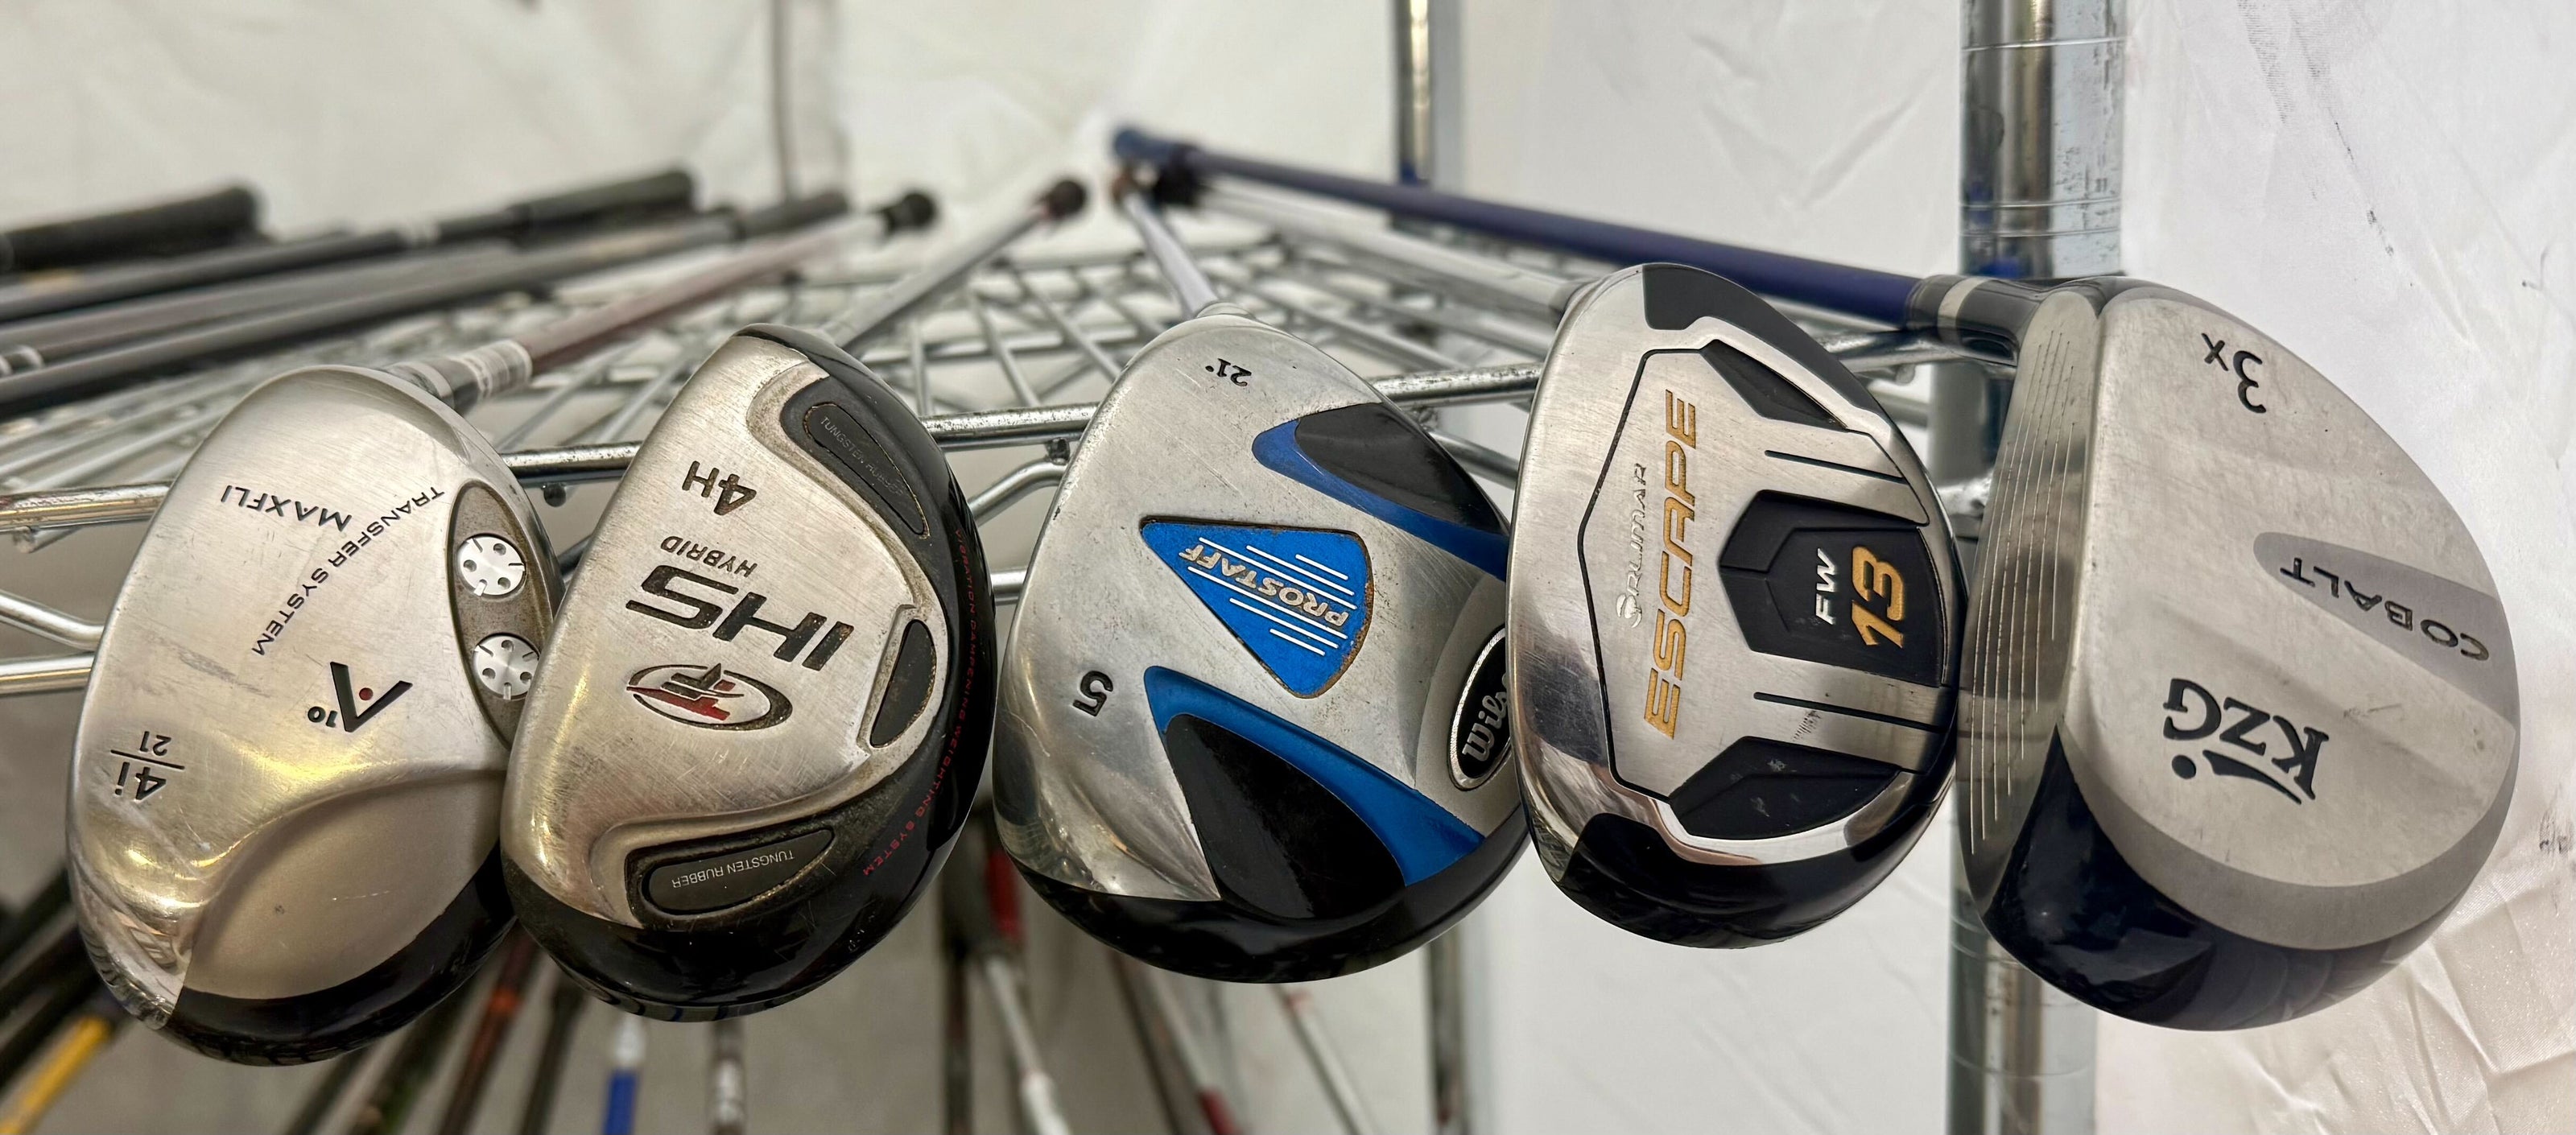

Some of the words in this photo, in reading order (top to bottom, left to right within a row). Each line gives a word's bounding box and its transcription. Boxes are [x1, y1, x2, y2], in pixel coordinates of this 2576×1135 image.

[221, 485, 353, 532] MAXFLI
[328, 485, 444, 568] TRANSFER
[681, 460, 757, 517] 4H
[660, 534, 759, 578] HYBRID
[955, 529, 977, 614] VIBRATION
[1179, 543, 1350, 628] PROSTAFF
[1643, 389, 1697, 741] ESCAPE
[1814, 548, 1838, 625] FW
[1851, 545, 1906, 650] 13
[251, 566, 330, 657] SYSTEM
[625, 563, 855, 672] IHS
[2280, 557, 2490, 662] COBALT
[959, 619, 977, 720] DAMPENING
[1072, 670, 1115, 718] 5
[139, 730, 172, 757] 21
[1461, 673, 1508, 762] Wils
[2162, 677, 2330, 802] KZG
[915, 725, 962, 818] WEIGHTING
[671, 863, 724, 889] RUBBER
[727, 849, 795, 877] TUNGSTEN
[863, 819, 916, 877] SYSTEM
